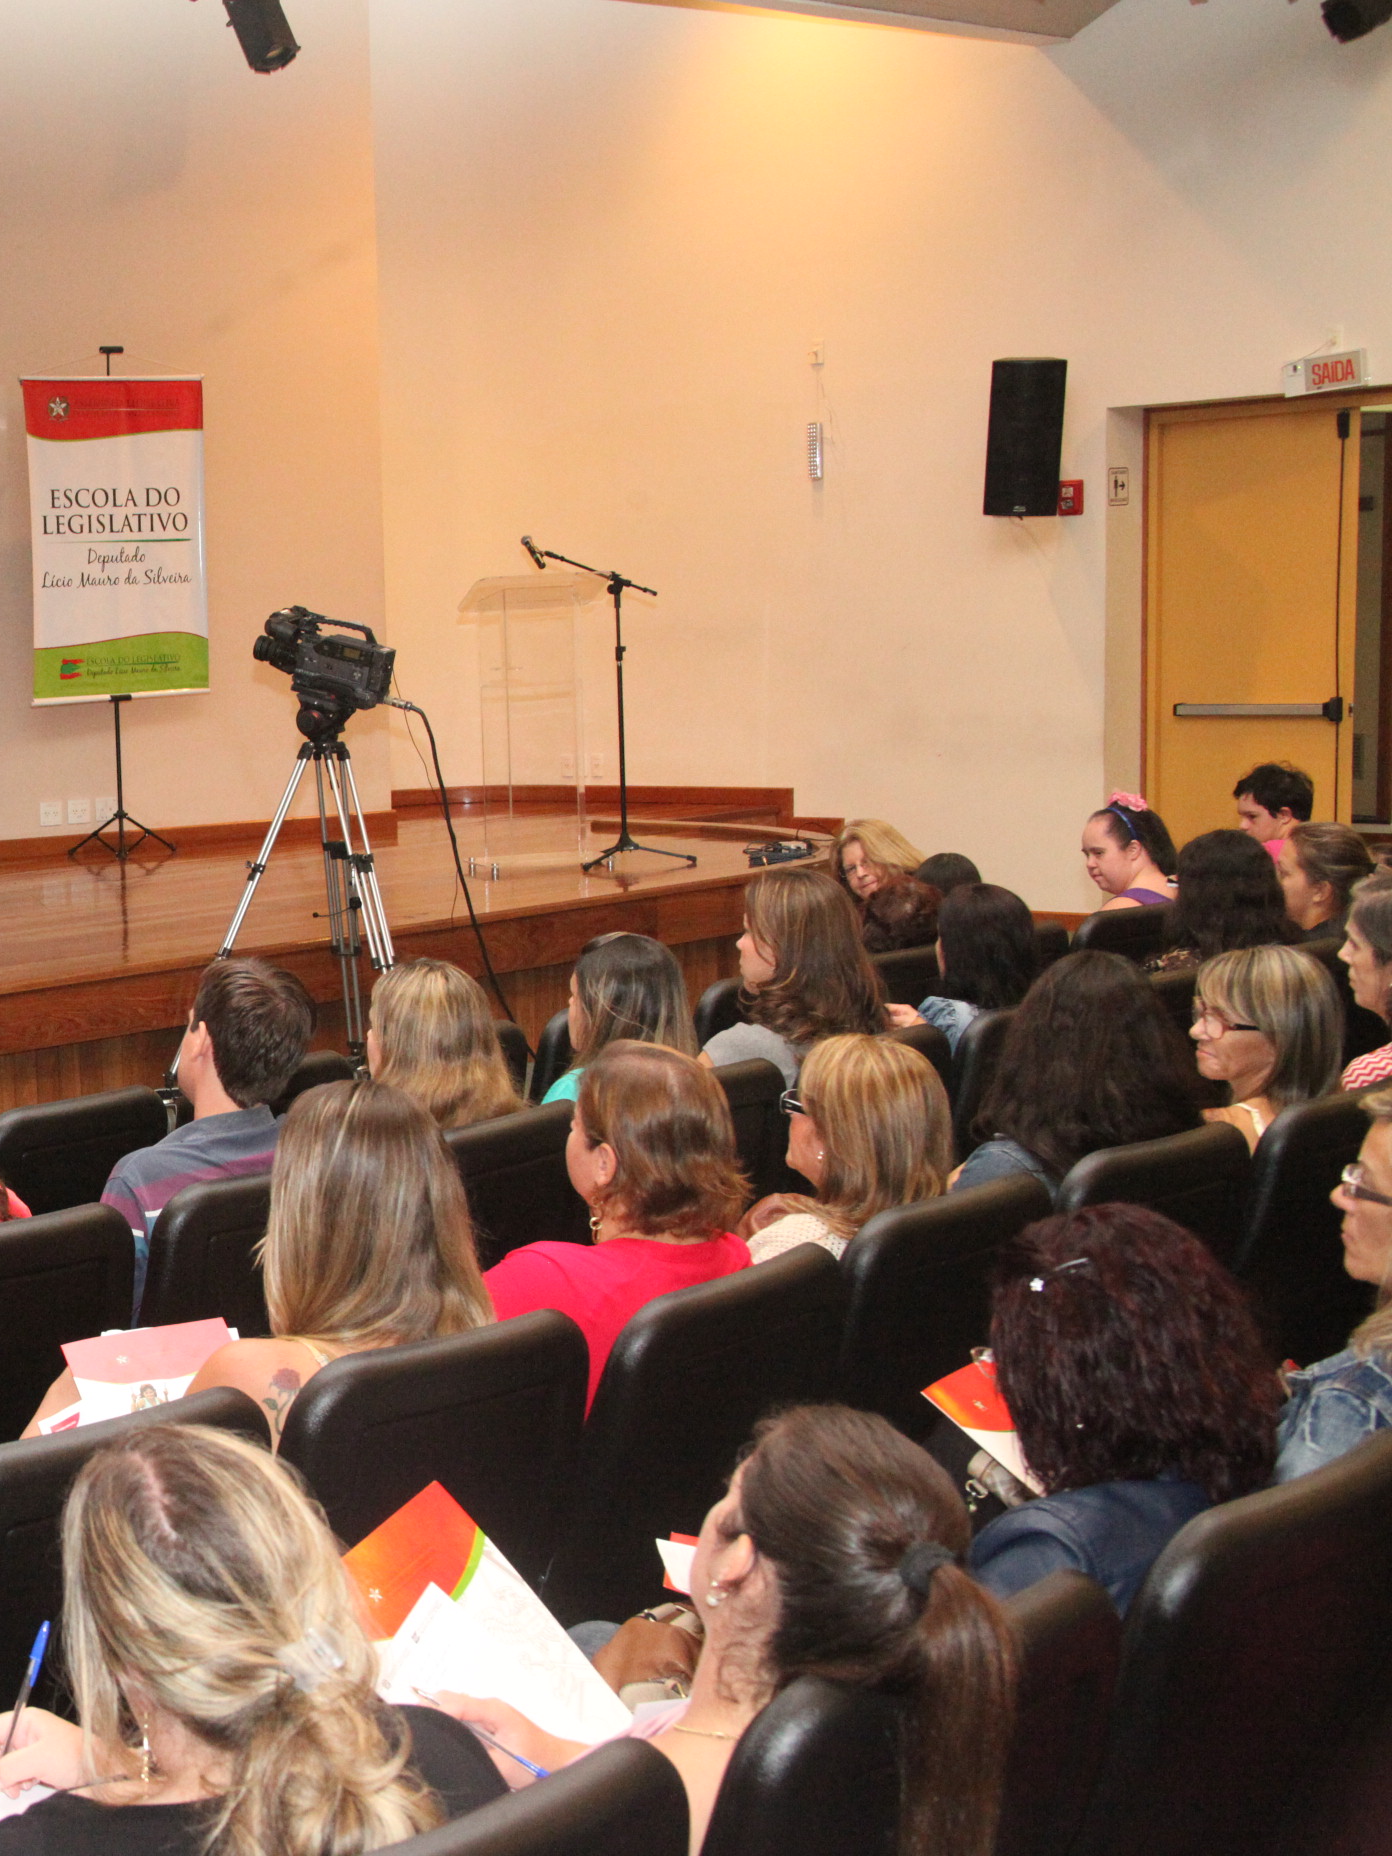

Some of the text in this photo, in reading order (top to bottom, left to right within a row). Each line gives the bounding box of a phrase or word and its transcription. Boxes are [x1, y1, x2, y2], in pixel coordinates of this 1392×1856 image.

[50, 486, 181, 509] ESCOLA DO
[42, 512, 189, 535] LEGISLATIVO
[87, 546, 146, 572] Deputado
[42, 566, 192, 589] Lício Mauro da Silveira
